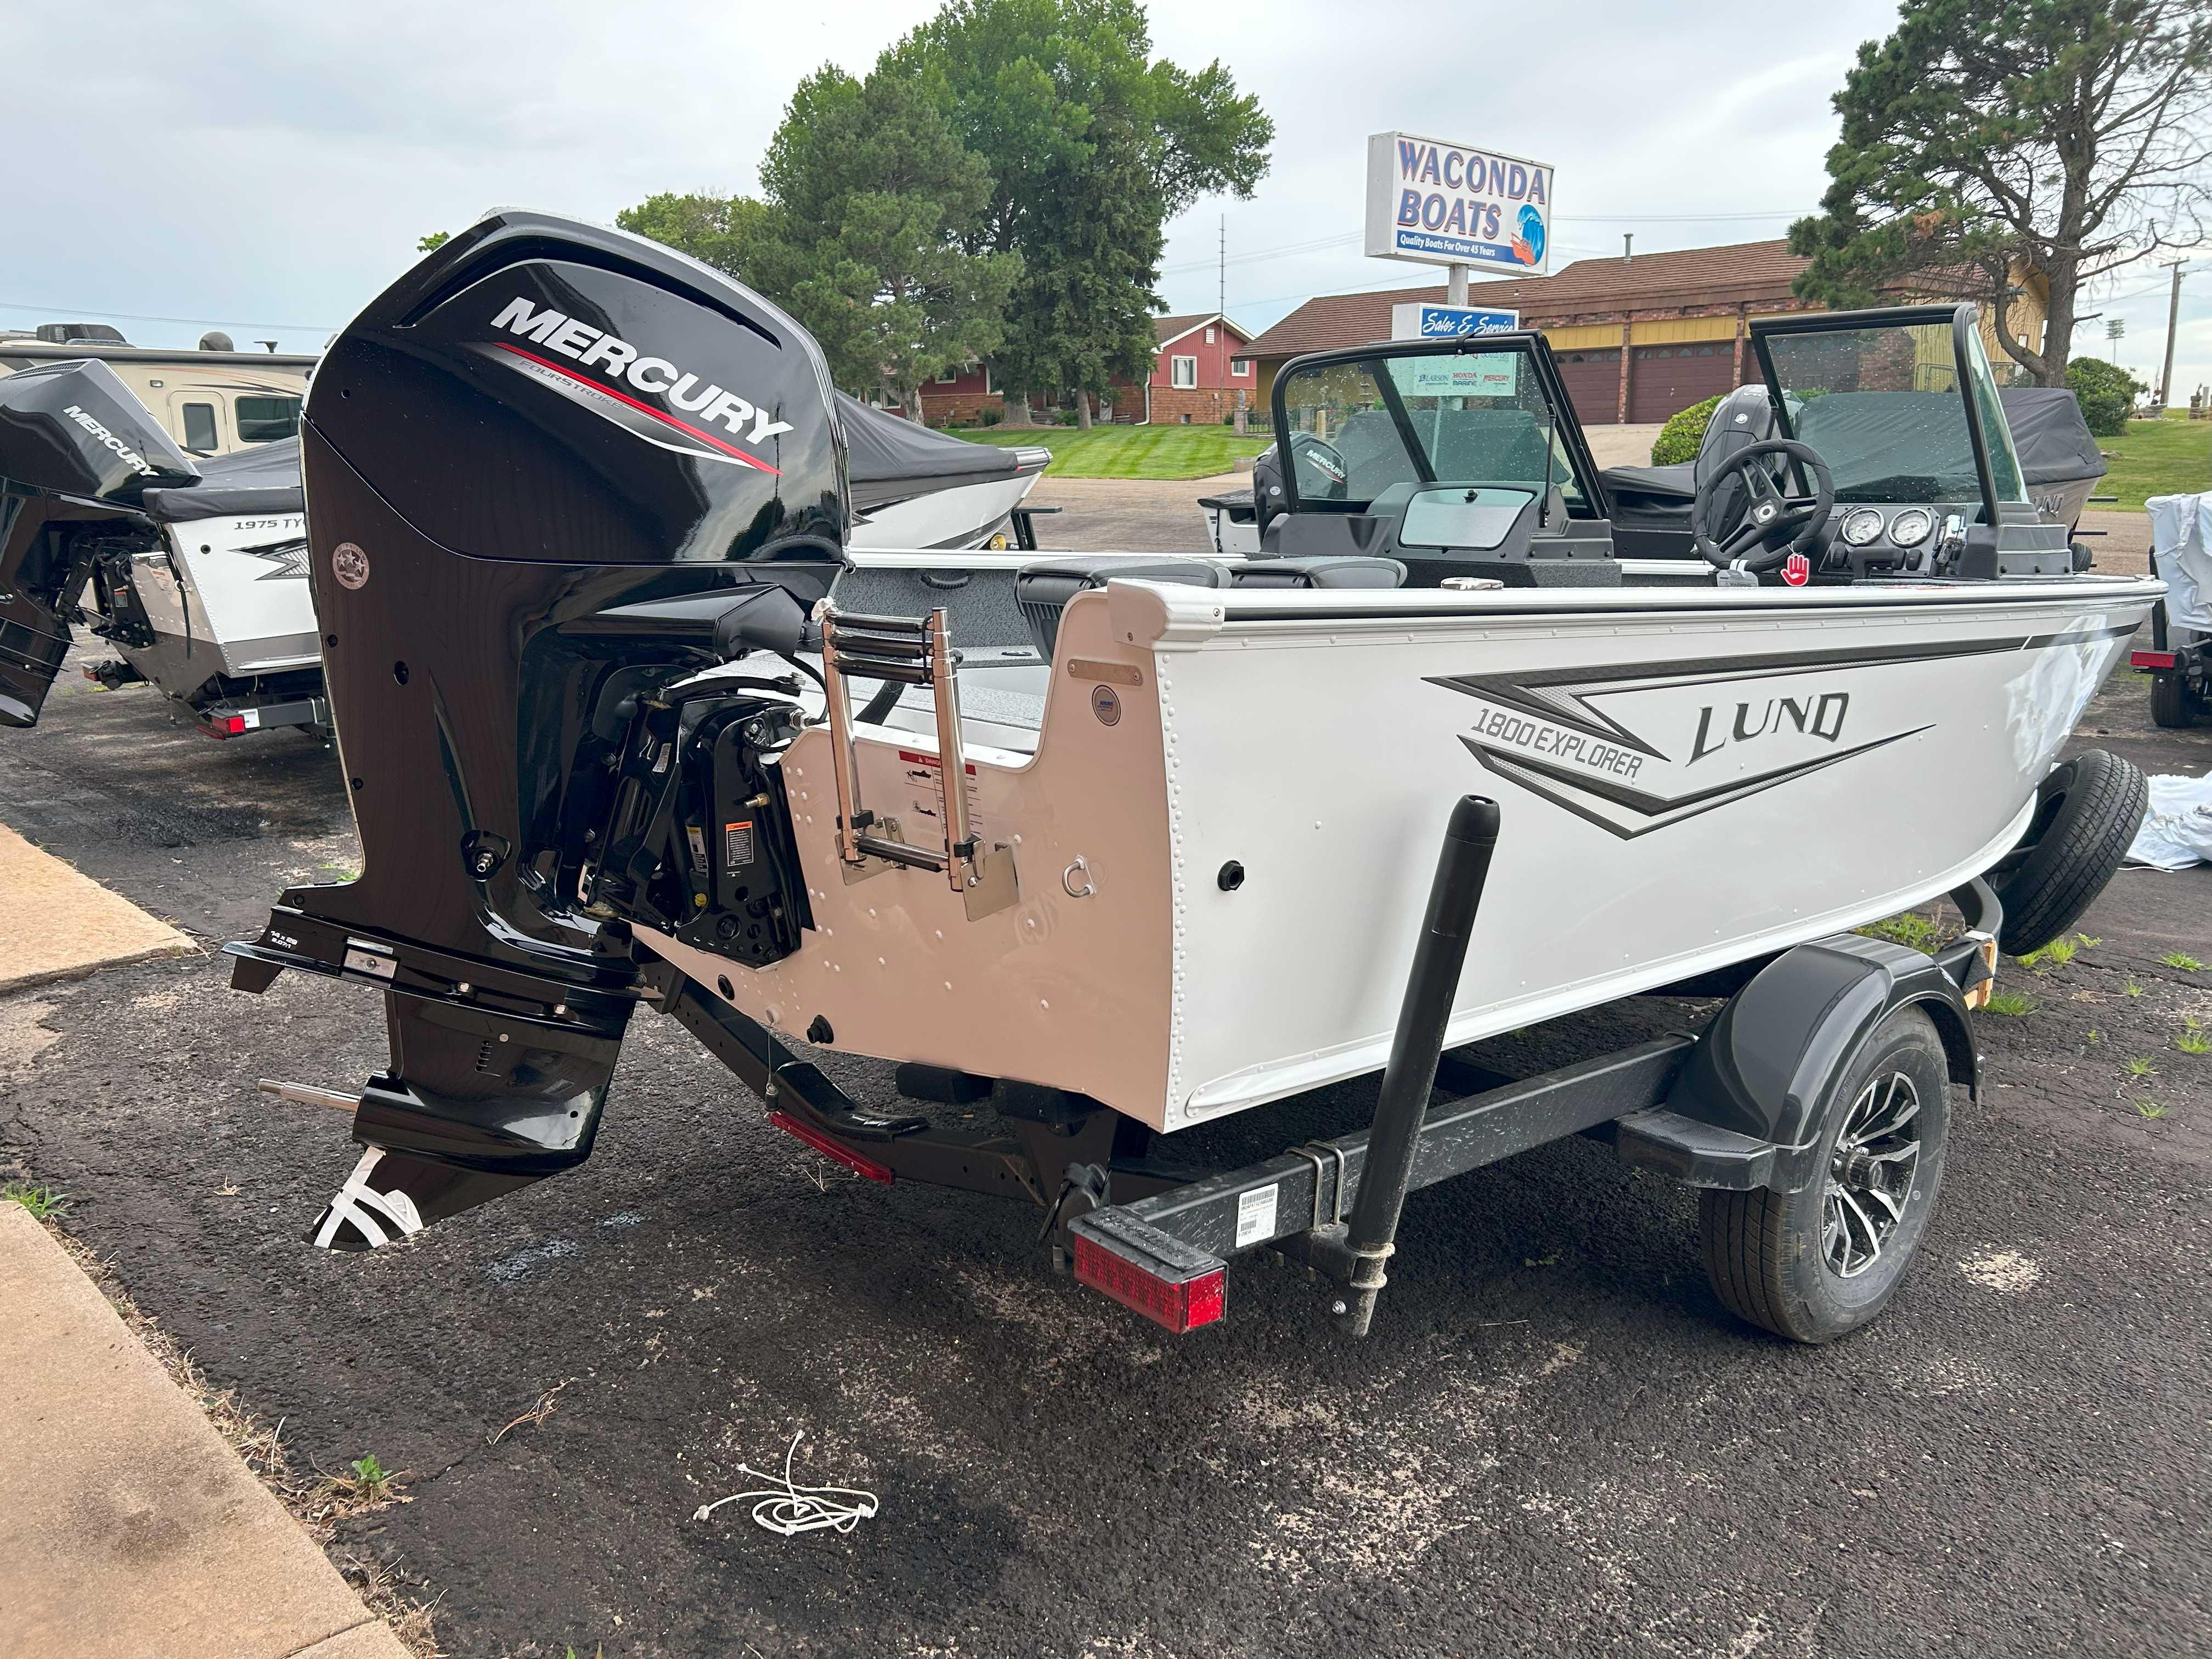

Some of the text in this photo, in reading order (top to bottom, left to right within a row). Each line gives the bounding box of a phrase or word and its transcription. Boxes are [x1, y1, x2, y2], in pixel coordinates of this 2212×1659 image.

[1398, 139, 1545, 205] WACONDA
[1397, 188, 1502, 240] BOATS
[1400, 235, 1496, 257] Quality Boats For Over 45 Years
[1423, 312, 1514, 334] Sales & Service
[490, 296, 794, 445] MERCURY
[517, 359, 624, 410] FOURSTROKE
[63, 405, 160, 477] MERCURY
[1305, 449, 1346, 479] MERCURY
[233, 518, 305, 530] 1975 TY
[1470, 708, 1643, 778] 1800 EXPLORER
[1685, 691, 1849, 768] LUND
